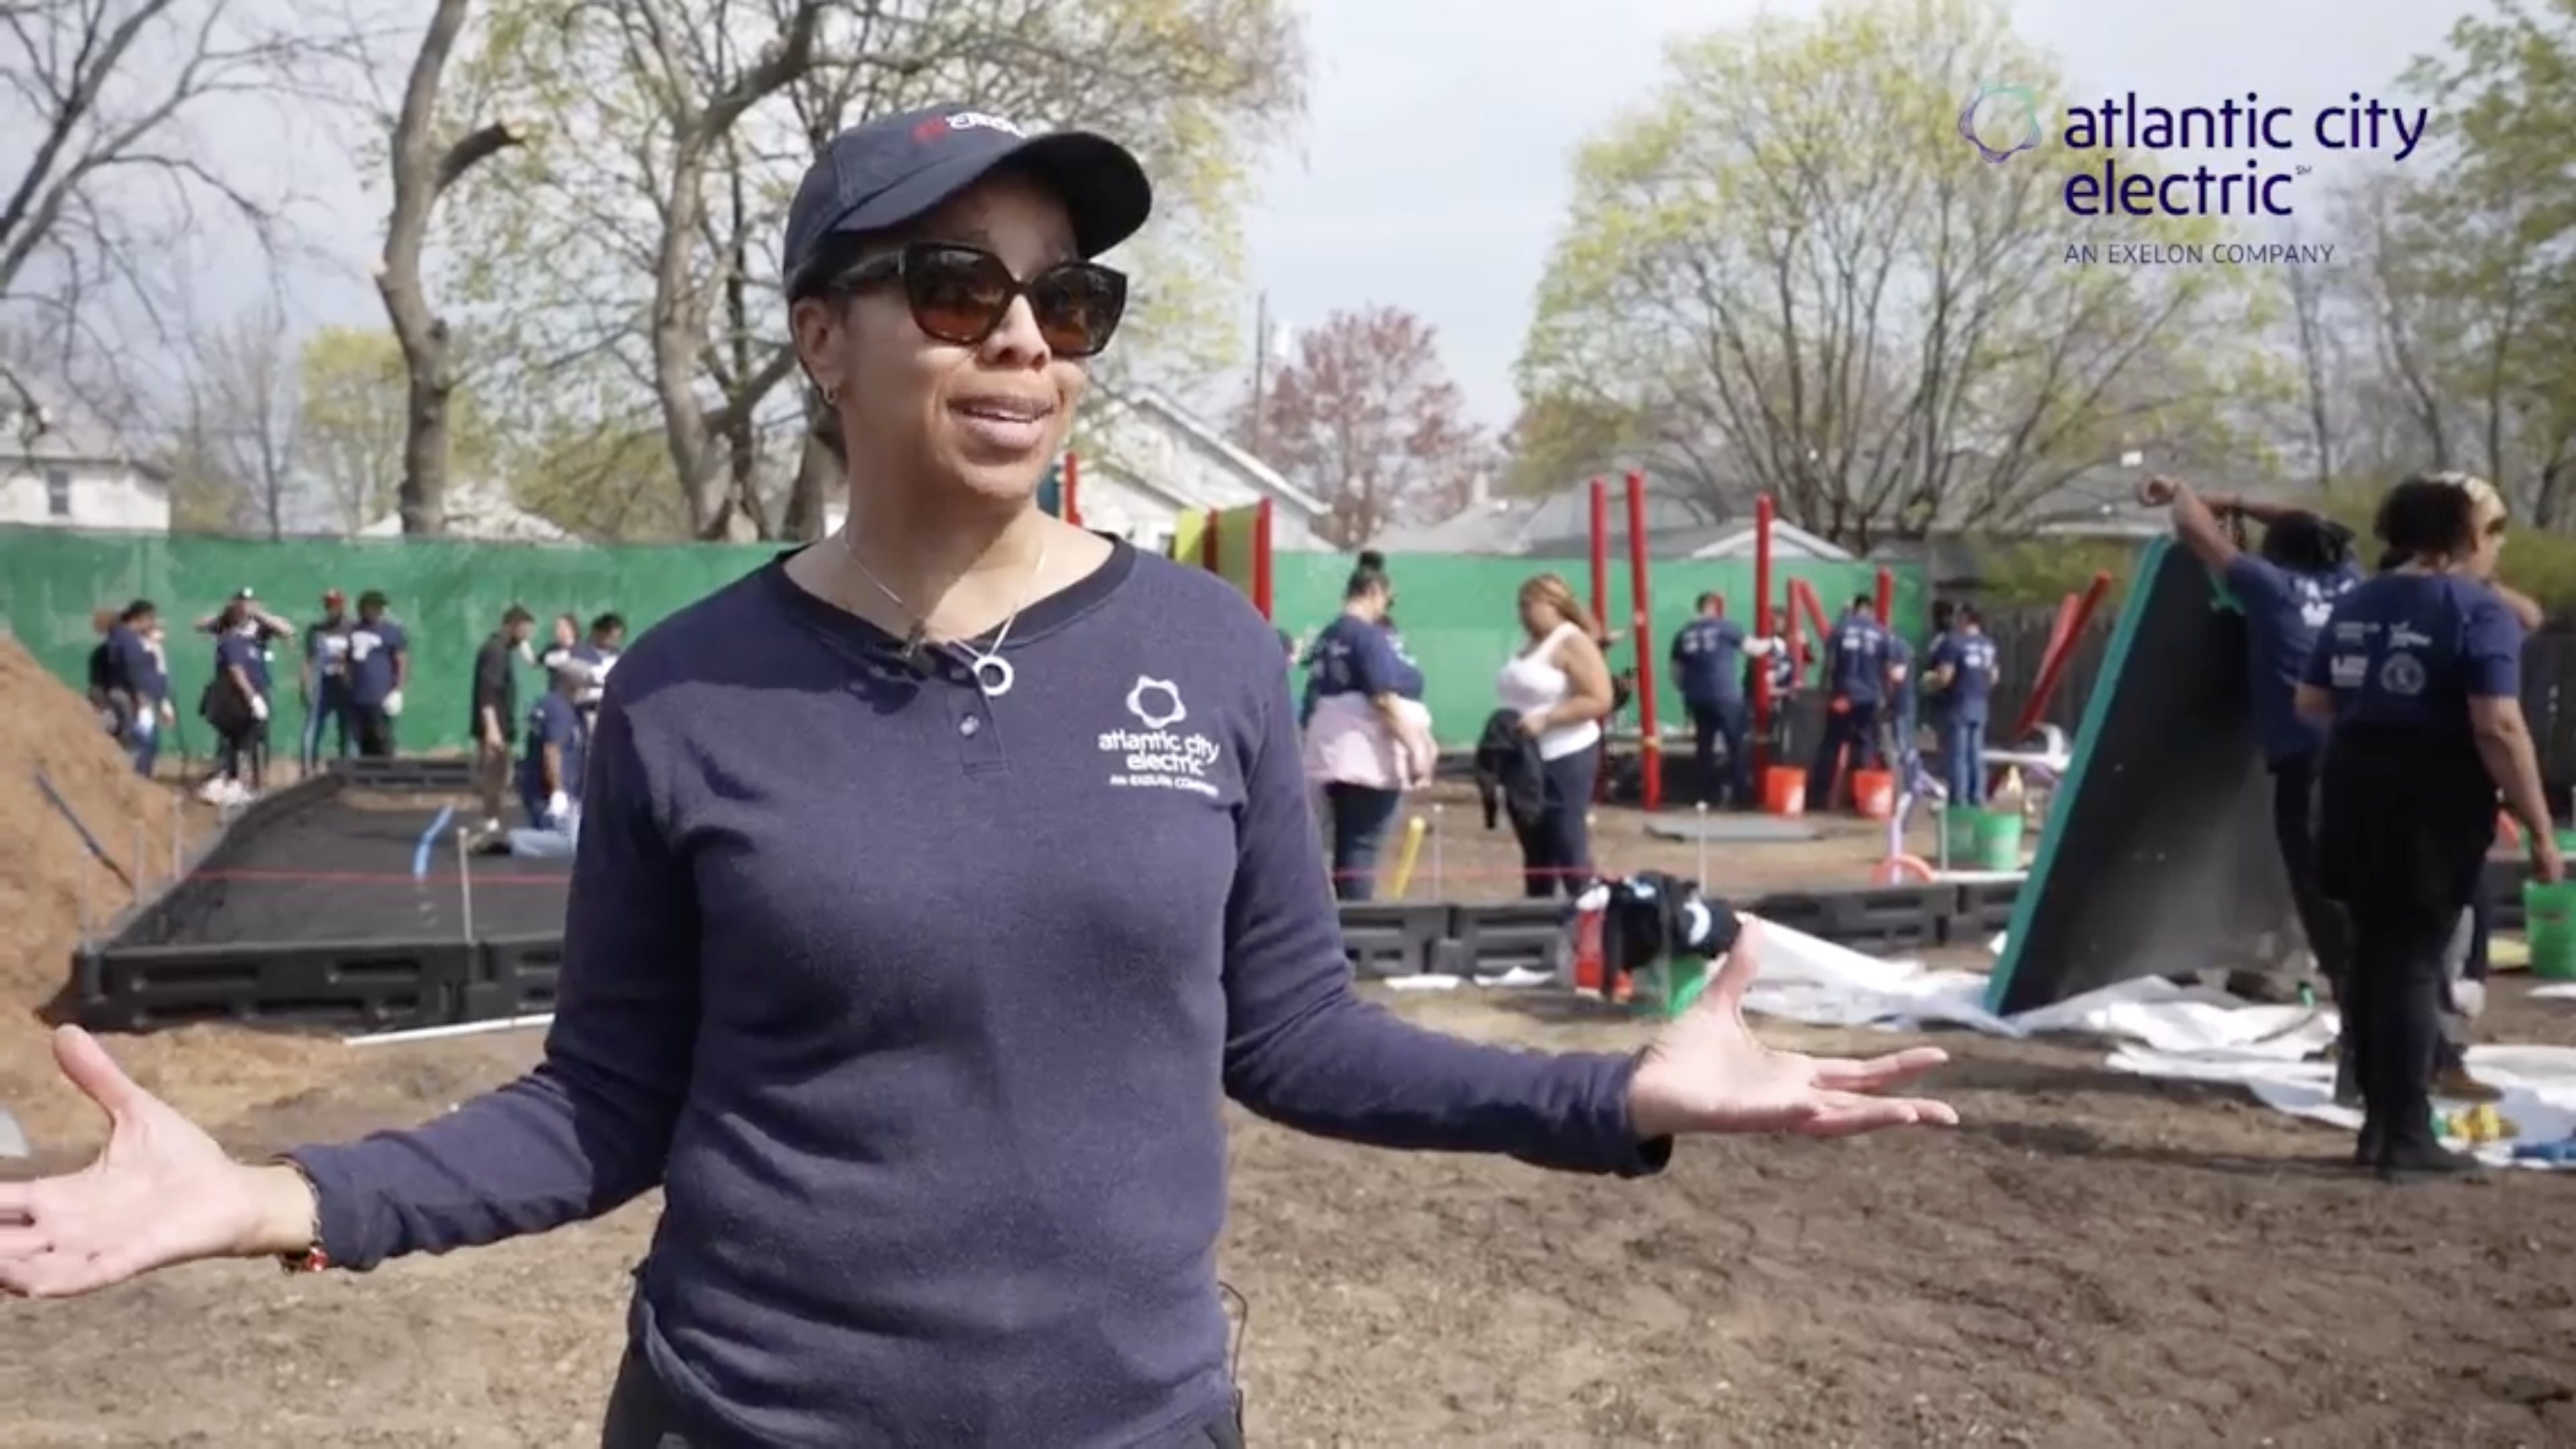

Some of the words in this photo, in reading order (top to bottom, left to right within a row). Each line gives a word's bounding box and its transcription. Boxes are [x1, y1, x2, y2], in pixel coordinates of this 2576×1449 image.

[1097, 728, 1183, 751] atlantic
[1184, 733, 1220, 764] city
[1126, 749, 1205, 777] electric
